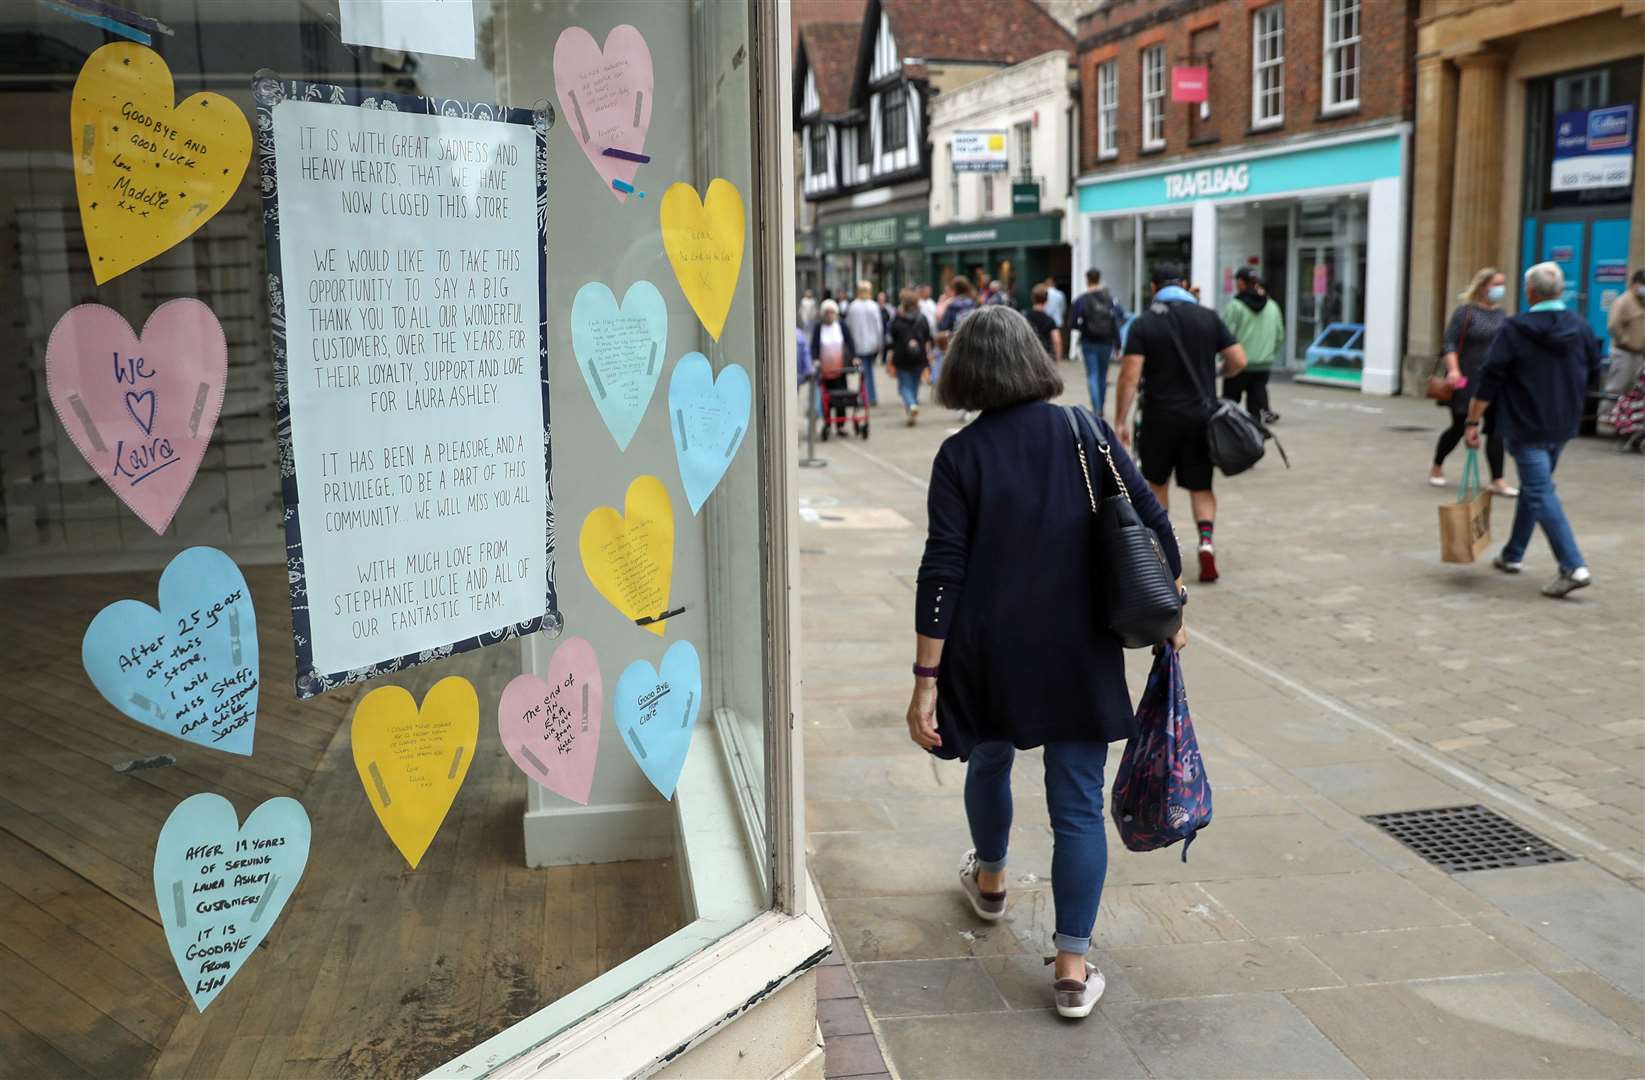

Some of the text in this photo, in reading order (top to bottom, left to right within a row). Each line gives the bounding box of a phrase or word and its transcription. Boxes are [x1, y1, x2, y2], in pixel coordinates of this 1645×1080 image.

[121, 102, 208, 154] GOODBYE AND
[131, 135, 197, 169] GOOD LUCK
[300, 127, 518, 167] IT IS WITH GREAT SADNESS AND
[302, 157, 346, 181] HEAVY
[408, 165, 441, 186] THAT
[450, 168, 468, 187] WE
[480, 169, 507, 191] HAVE
[1164, 164, 1249, 201] TRAVELBAG
[113, 176, 169, 210] Maddie
[342, 191, 372, 214] NOW
[382, 193, 428, 217] CLOSED
[437, 194, 467, 218] THIS
[314, 249, 520, 273] WE WOULD LIKE TO TAKE THIS
[309, 278, 509, 303] OPPORTUNITY TO SAY A BIG
[309, 304, 523, 332] THANK YOU TO ALL OUR WONDERFUL
[313, 336, 391, 361] CUSTOMERS,
[397, 334, 425, 356] OVER
[433, 332, 456, 353] THE
[509, 330, 526, 350] FOR
[113, 352, 156, 385] We
[314, 357, 525, 388] THEIR LOYALTY, SUPPORT AND LOVE
[371, 391, 397, 413] FOR
[407, 386, 445, 411] LAURA
[113, 438, 174, 478] Laura
[322, 435, 524, 477] IT HAS BEEN A PLEASURE, AND A
[400, 474, 412, 495] TO
[418, 471, 433, 492] BE
[440, 471, 447, 489] A
[453, 466, 479, 487] PART
[484, 464, 497, 481] OF
[504, 461, 526, 479] THIS
[415, 500, 430, 520] WE
[437, 497, 461, 517] WILL
[467, 493, 489, 513] MISS
[495, 490, 511, 507] YOU
[514, 487, 530, 504] ALL
[357, 539, 508, 583] WITH MUCH LOVE FROM
[335, 558, 530, 616] STEPHANIE, LUCIE AND ALL OF
[119, 590, 241, 673] After 25 years
[352, 618, 379, 639] OUR
[392, 600, 460, 631] FANTASTIC
[146, 637, 202, 679] at this
[171, 672, 209, 700] I will
[523, 673, 575, 724] The end of
[176, 695, 205, 720] miss
[181, 714, 208, 736] and
[212, 711, 255, 742] Janet
[186, 837, 285, 860] AFTER 19 YEARS
[201, 856, 272, 874] OF SERVING
[193, 872, 270, 894] LAURA ASHLEY
[186, 935, 252, 961] GOODBYE
[198, 924, 236, 942] IT IS
[200, 960, 231, 974] FROM
